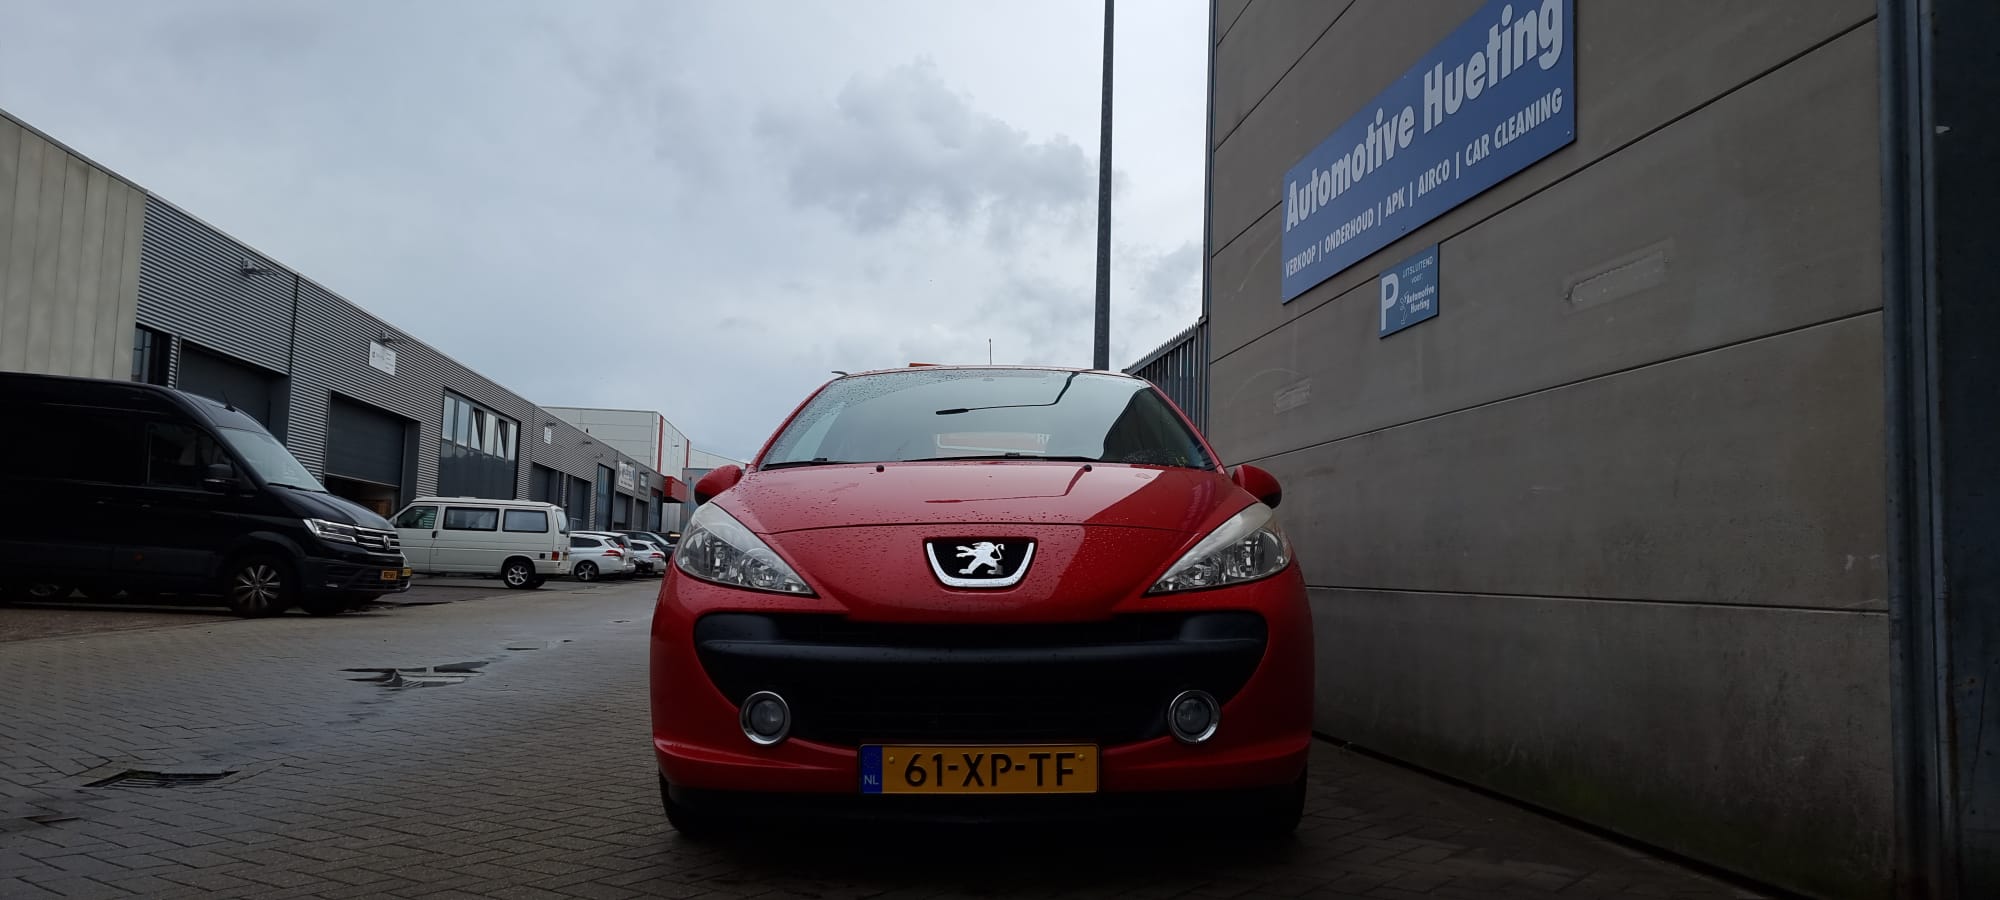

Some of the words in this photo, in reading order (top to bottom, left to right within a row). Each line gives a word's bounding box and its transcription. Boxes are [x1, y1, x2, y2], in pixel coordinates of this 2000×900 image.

[1285, 106, 1415, 232] Automotive
[1423, 0, 1564, 134] Hueting
[1285, 244, 1316, 279] VERKOOP
[1325, 207, 1374, 254] ONDERHOUD
[1385, 187, 1405, 217] APK
[1417, 160, 1450, 198] AIRCO
[1465, 134, 1489, 166] CAR
[1494, 87, 1562, 149] CLEANING
[1381, 273, 1399, 331] P
[1405, 284, 1435, 304] Automotive
[1410, 299, 1430, 313] Hueting
[864, 775, 879, 785] NL
[904, 753, 1075, 787] 61-XP-TF
